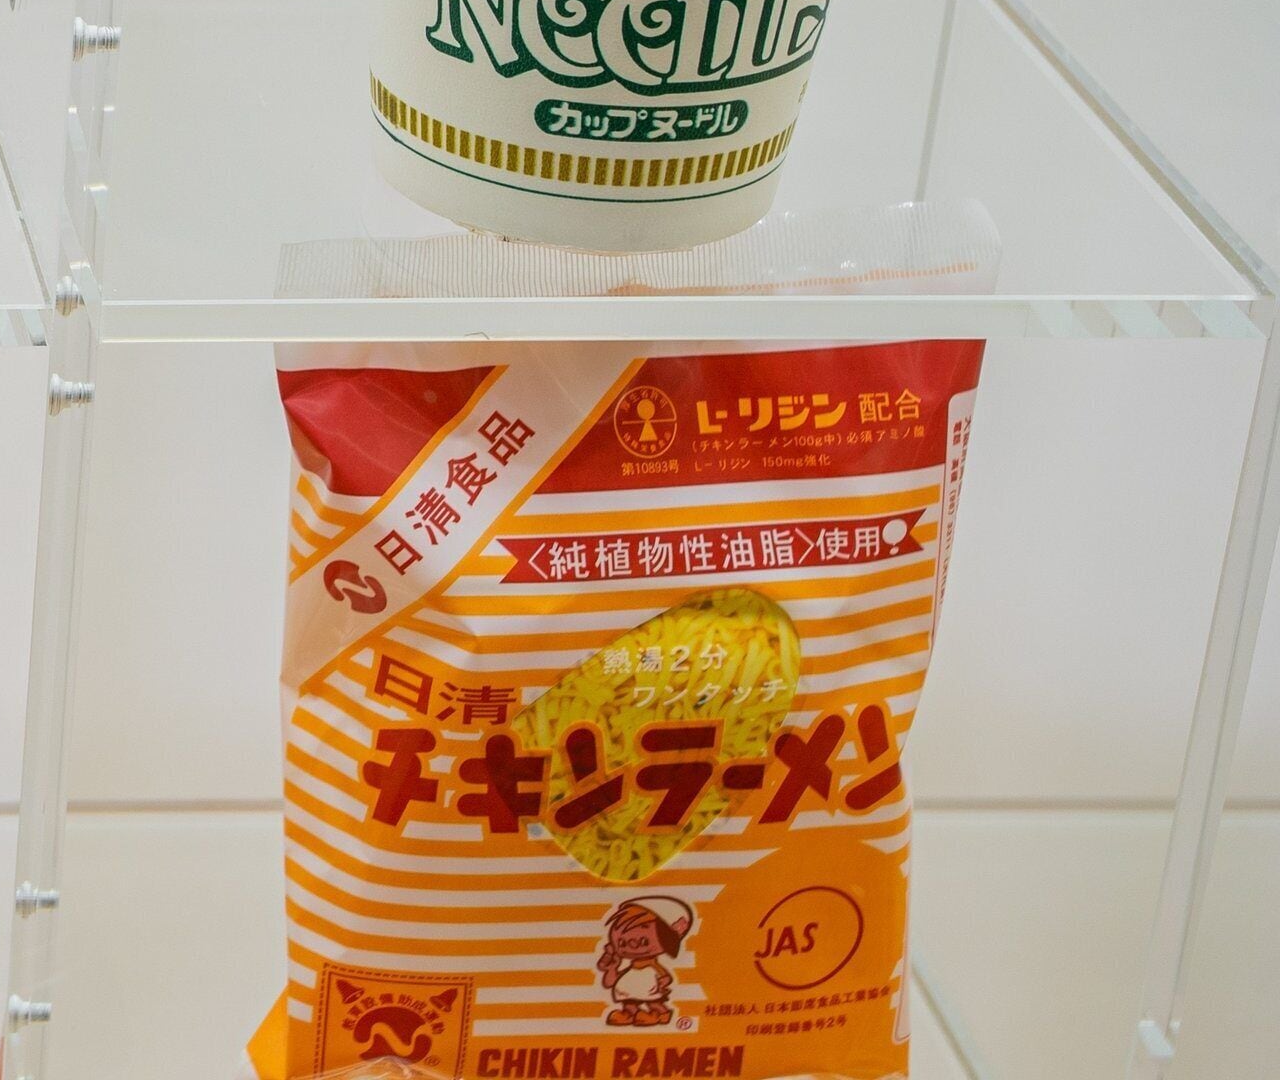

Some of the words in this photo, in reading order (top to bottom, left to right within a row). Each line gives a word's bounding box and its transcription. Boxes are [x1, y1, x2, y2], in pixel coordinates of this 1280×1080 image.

[549, 102, 739, 139] カップヌードル
[858, 388, 922, 423] 配合
[621, 458, 679, 476] 第10893号
[372, 410, 536, 577] 日清食品
[602, 644, 729, 677] 熱湯2分
[372, 655, 517, 728] 日清
[632, 678, 788, 708] ワンタッチ
[362, 703, 903, 836] チキンラーメン
[754, 922, 819, 958] JAS
[704, 1004, 759, 1017] 社団法人
[476, 1047, 600, 1079] CHIKIN
[610, 1045, 745, 1079] RAMEN
